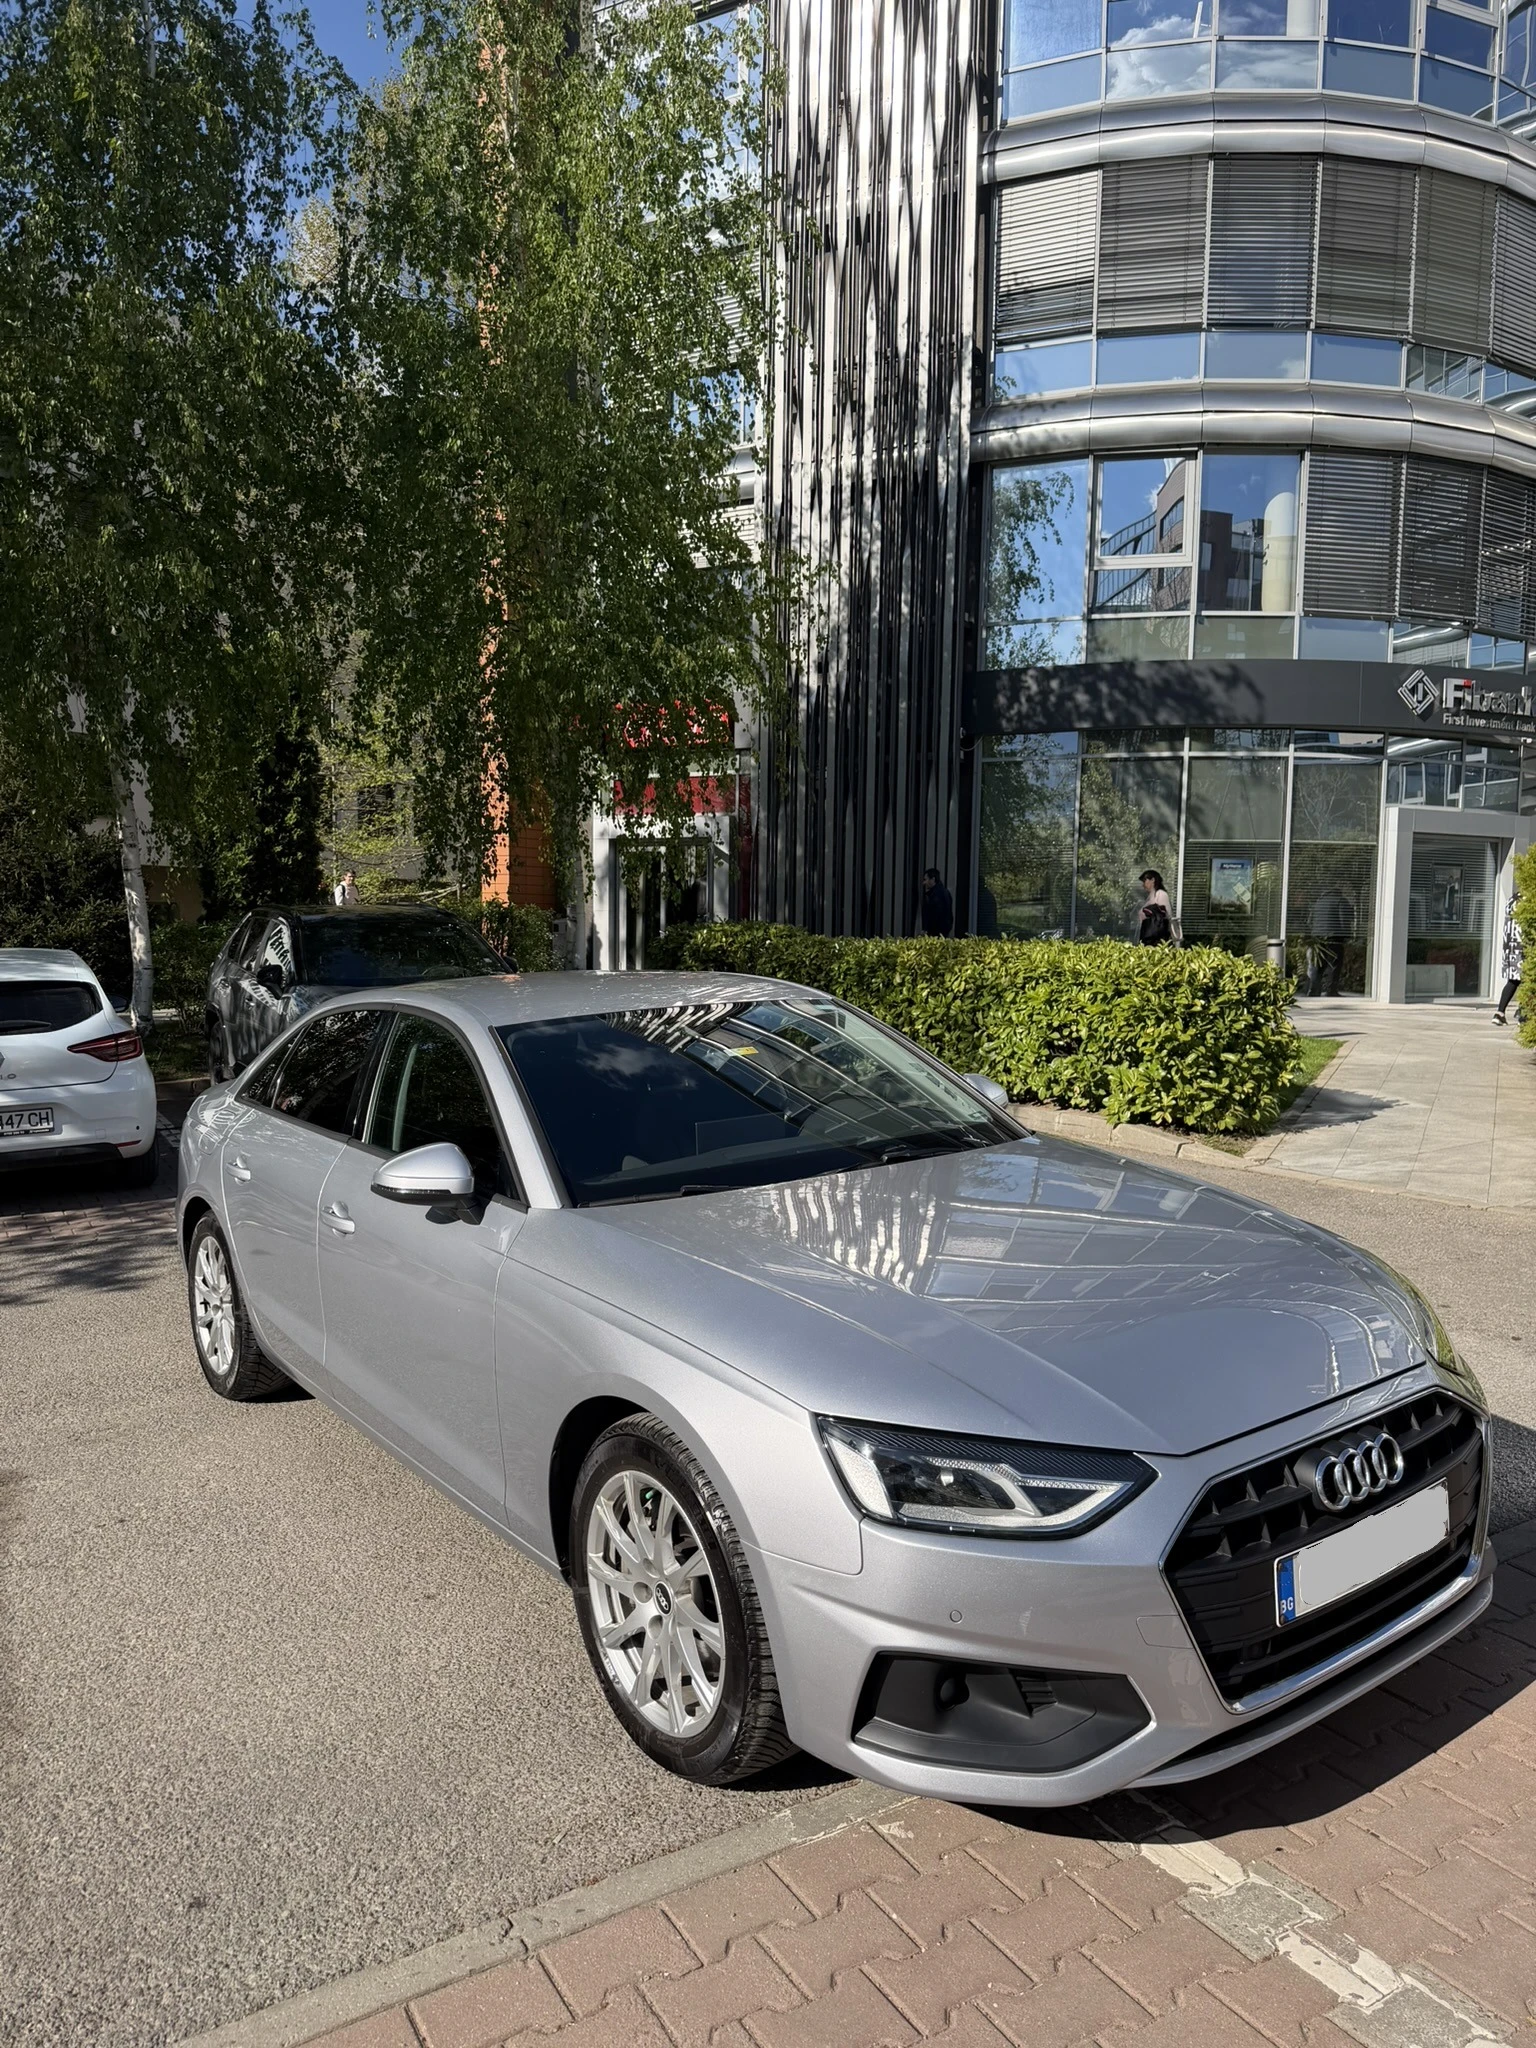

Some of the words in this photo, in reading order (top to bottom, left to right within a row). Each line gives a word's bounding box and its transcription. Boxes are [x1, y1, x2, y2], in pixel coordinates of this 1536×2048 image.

[1443, 713, 1464, 725] First
[1466, 715, 1515, 730] Investment
[1516, 720, 1536, 732] Bank
[28, 1111, 50, 1127] CH
[1280, 1597, 1294, 1614] BG
